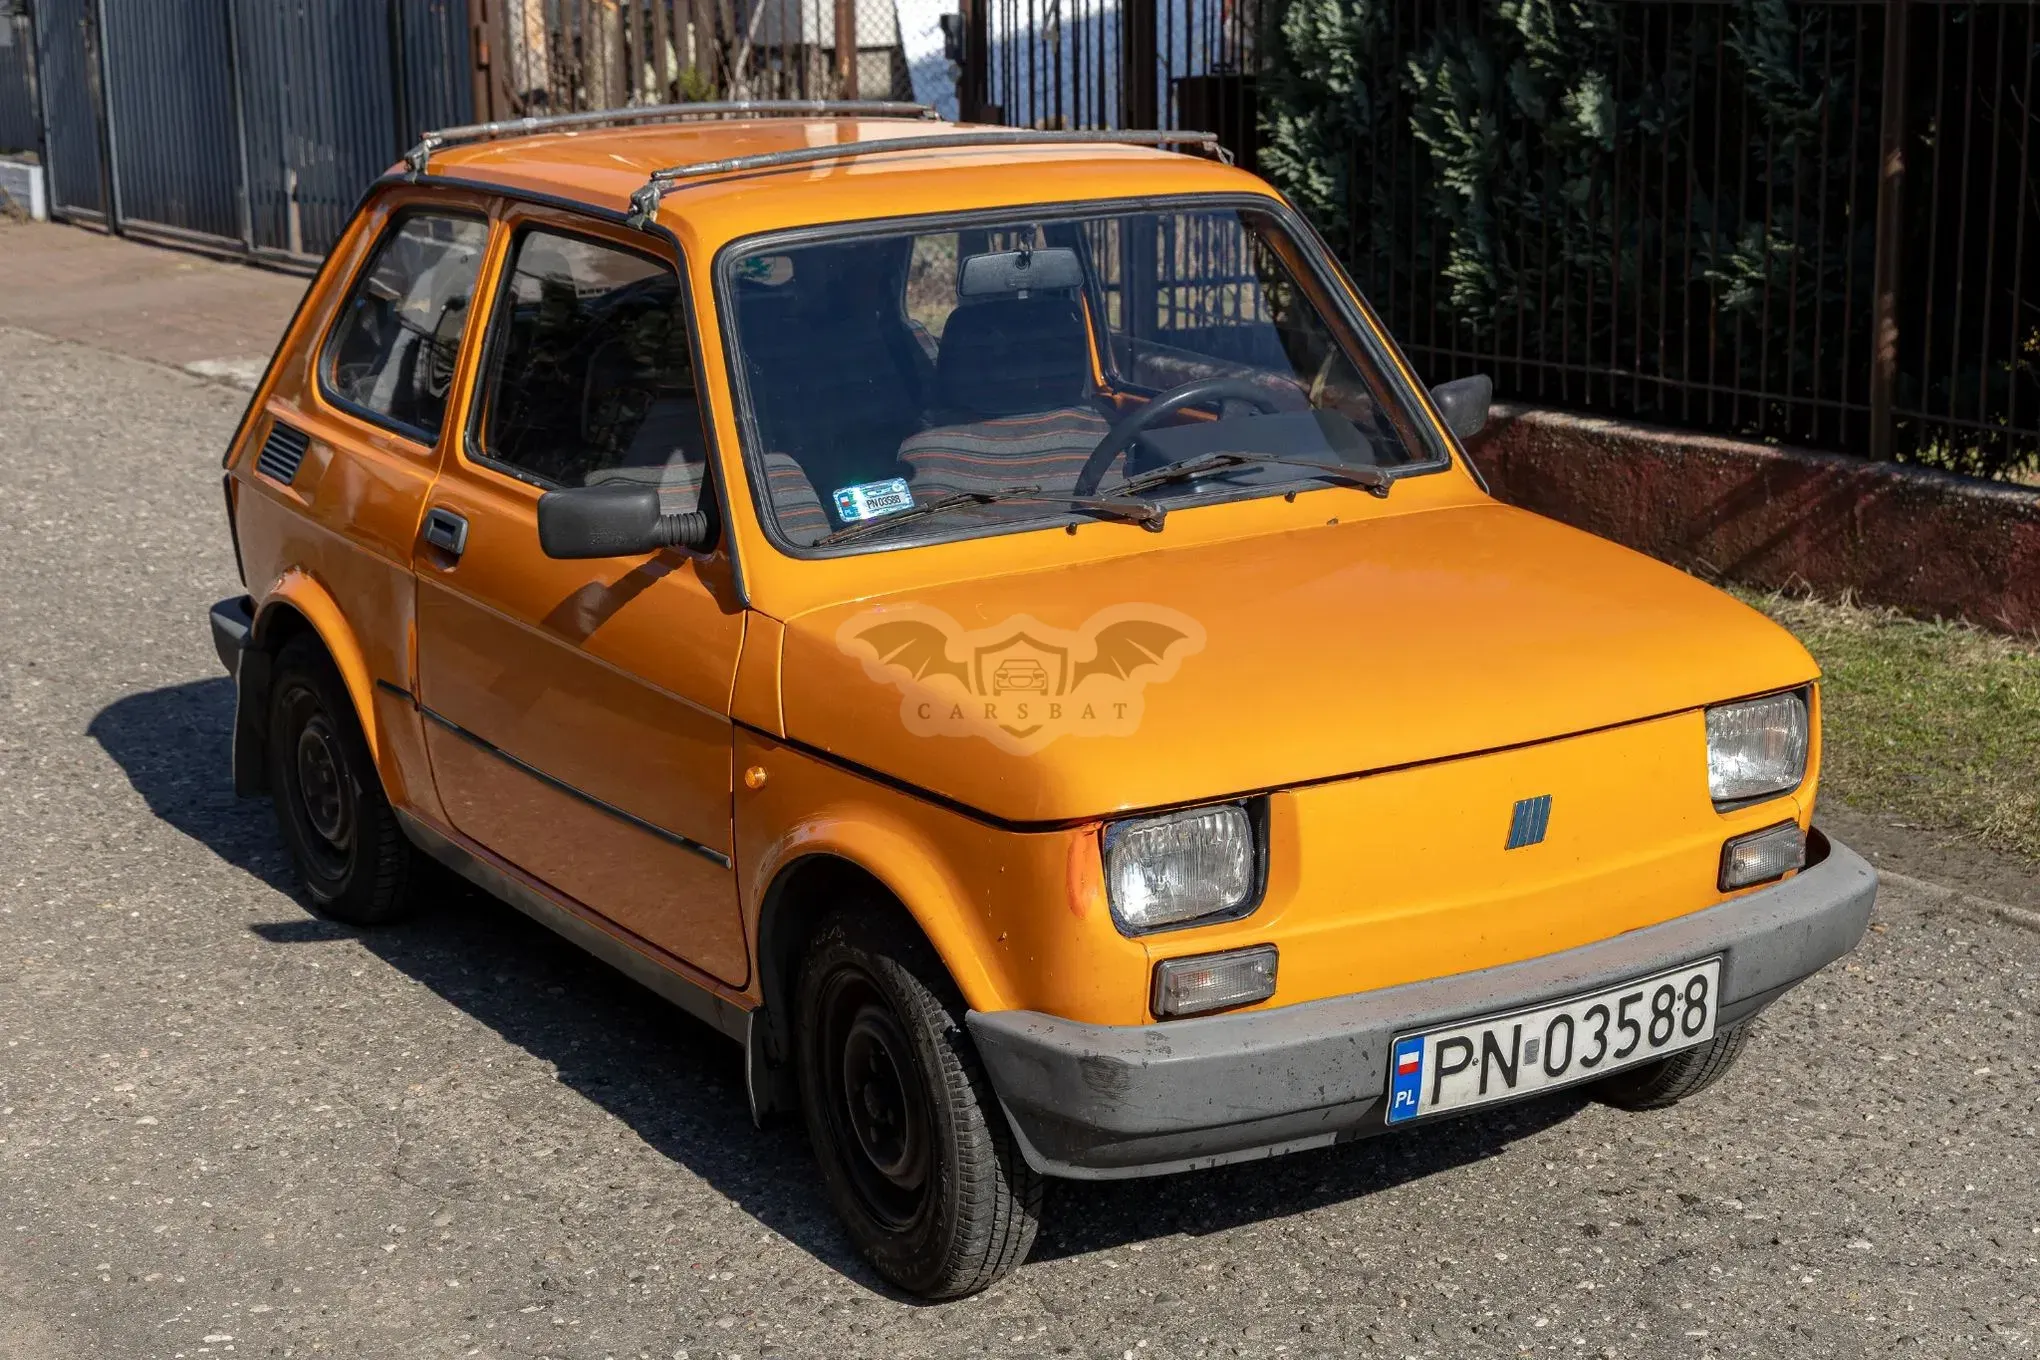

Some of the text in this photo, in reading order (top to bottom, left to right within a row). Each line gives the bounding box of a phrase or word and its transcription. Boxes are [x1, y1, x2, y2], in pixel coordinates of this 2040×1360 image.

[866, 497, 879, 509] PN
[1431, 974, 1708, 1105] PN 03588
[1395, 1089, 1415, 1108] PL
